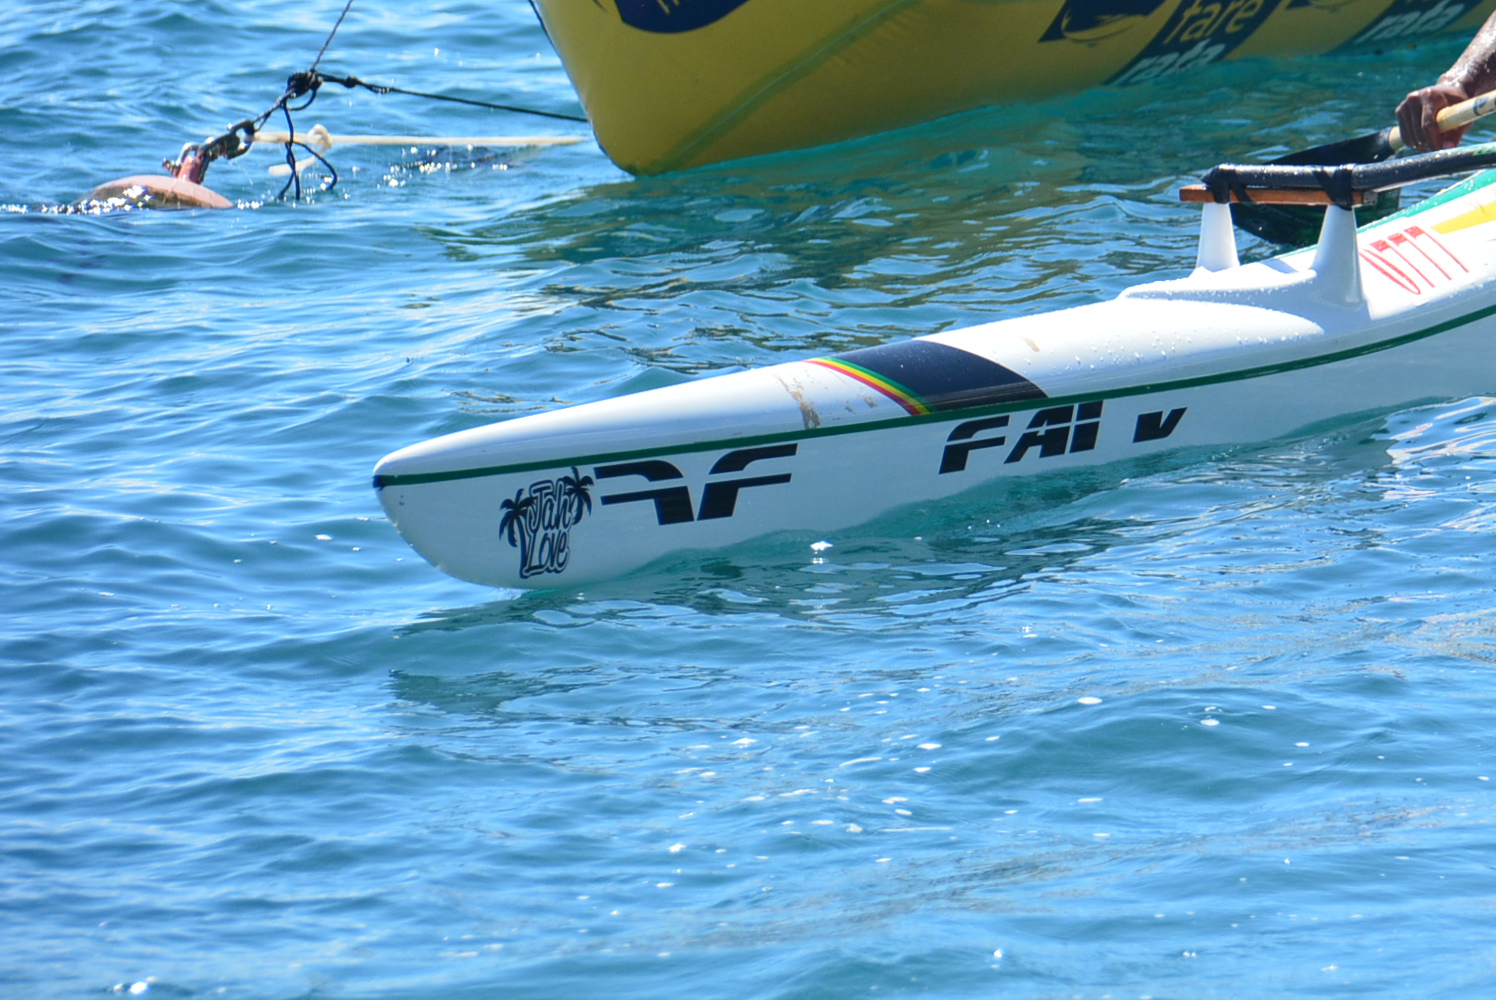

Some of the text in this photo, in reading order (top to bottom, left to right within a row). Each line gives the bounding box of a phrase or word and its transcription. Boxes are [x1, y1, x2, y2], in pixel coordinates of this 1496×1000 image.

[938, 400, 1103, 475] FAI
[527, 478, 572, 532] Jah
[520, 528, 570, 579] Love
